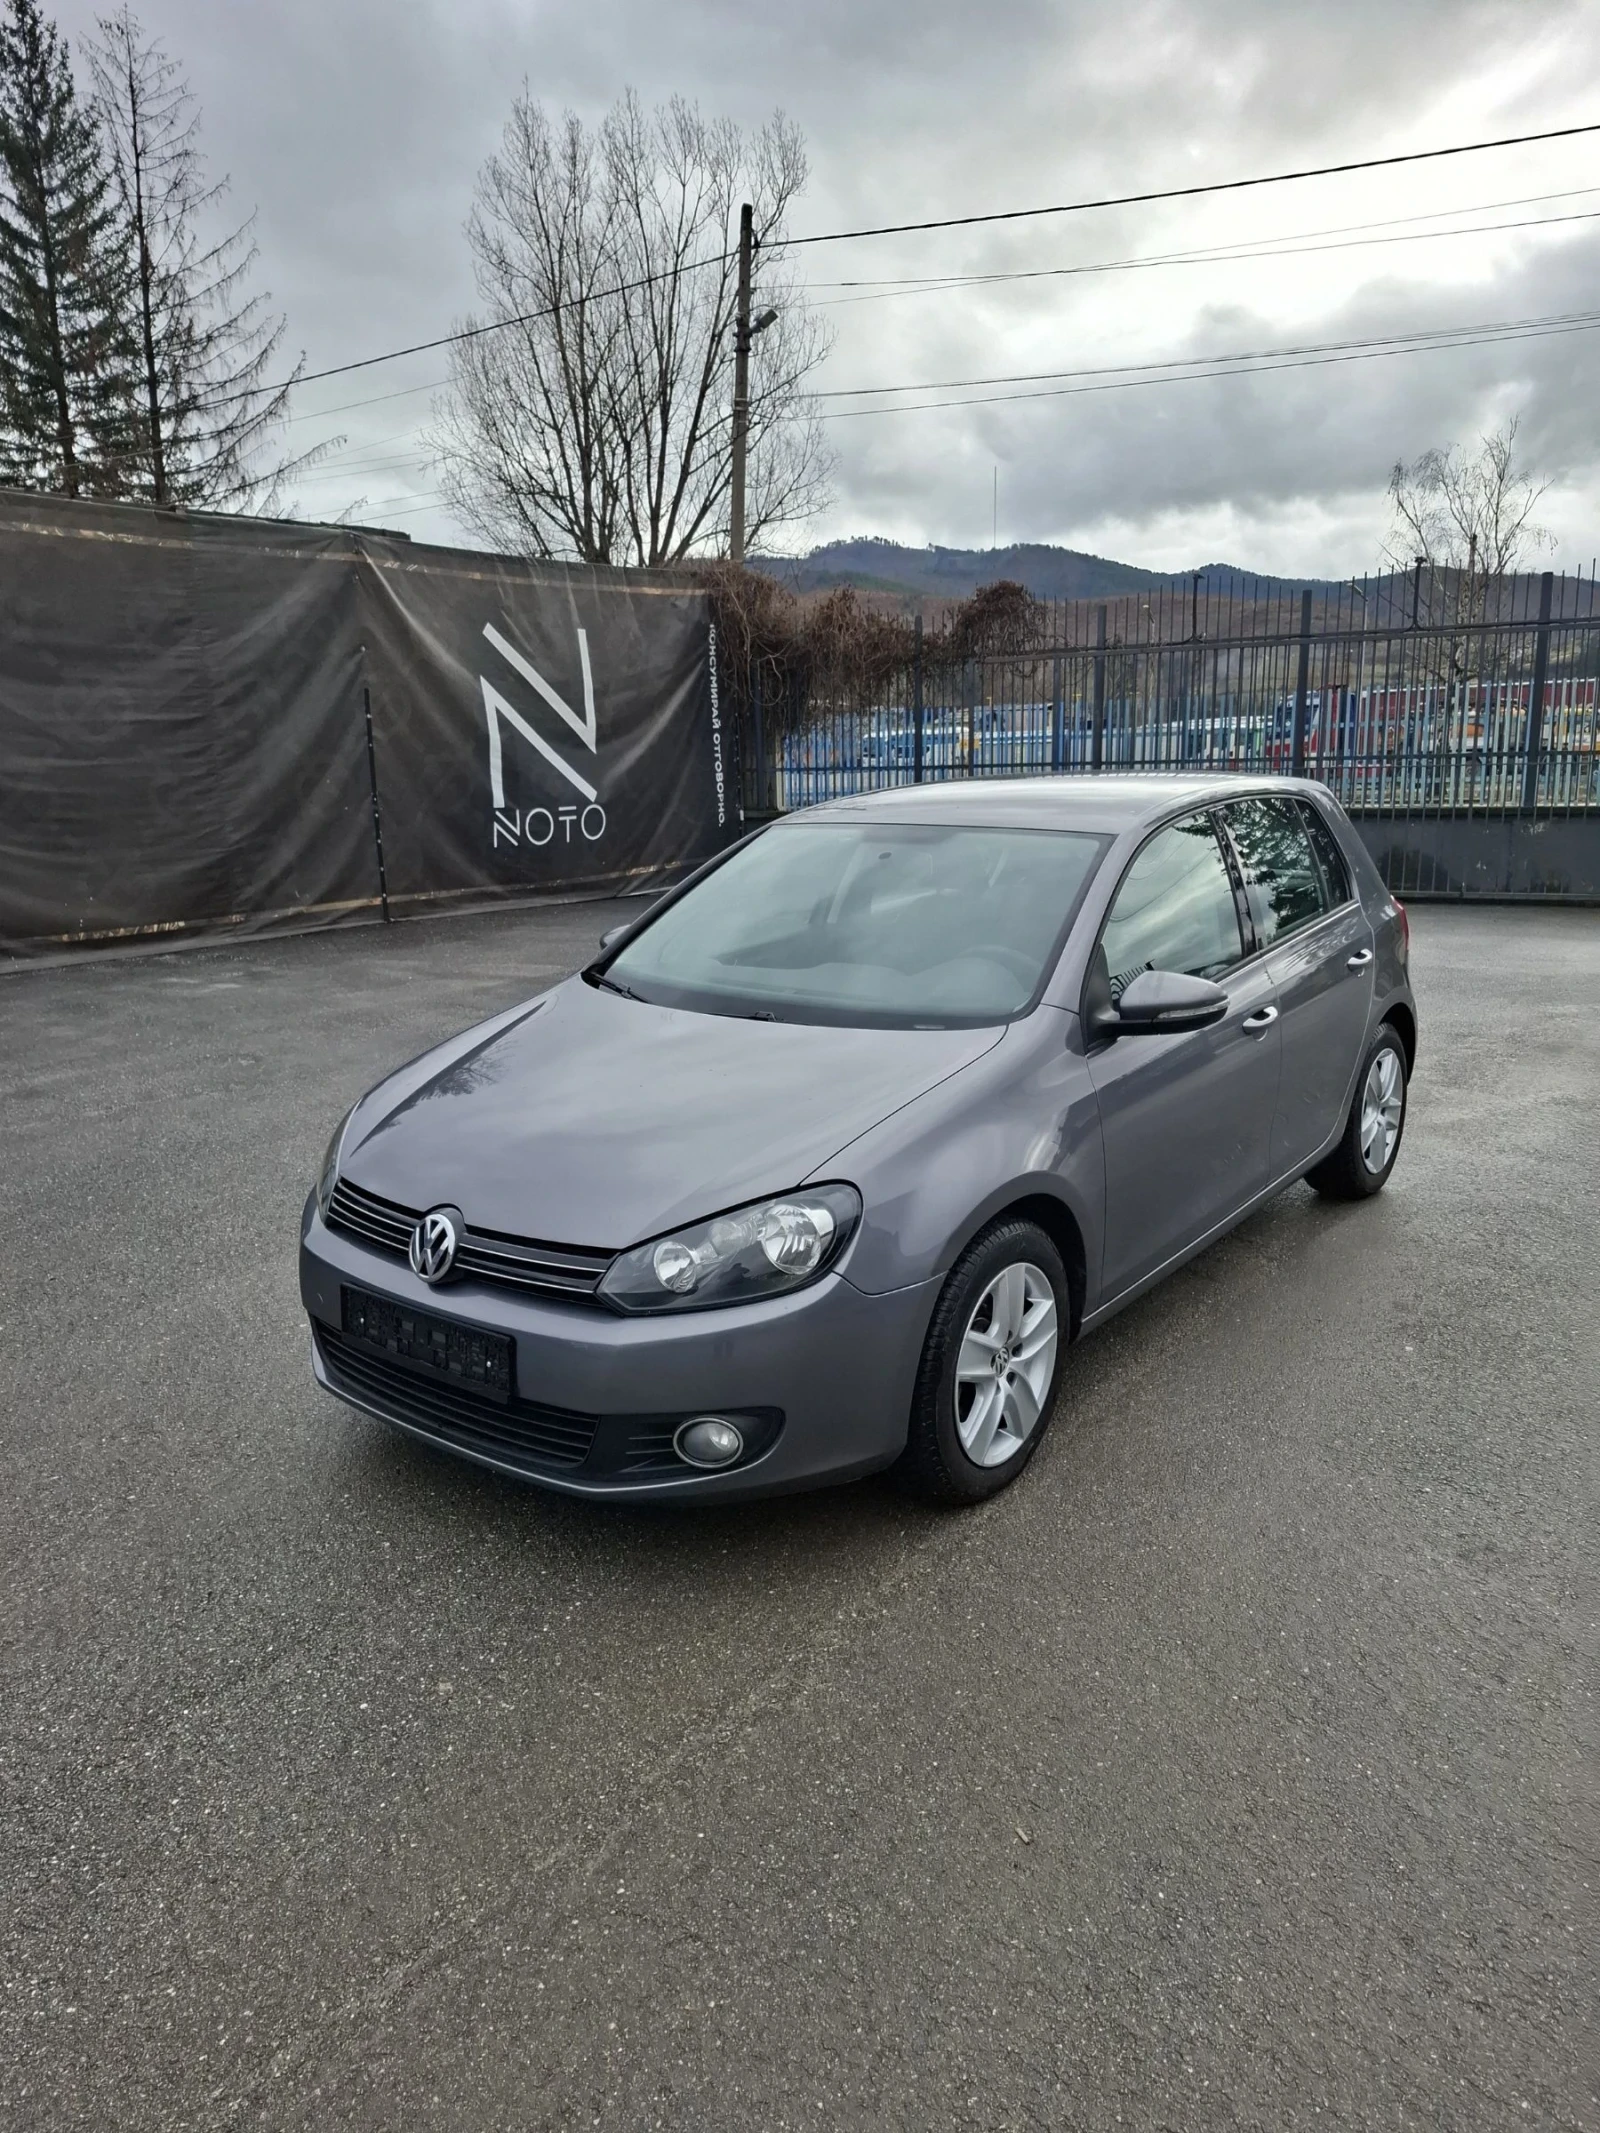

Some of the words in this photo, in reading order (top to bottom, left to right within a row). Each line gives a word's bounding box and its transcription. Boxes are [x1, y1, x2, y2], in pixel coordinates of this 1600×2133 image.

[709, 624, 721, 729] КОНСУМИРАЙ
[494, 804, 606, 848] NOTO
[713, 732, 725, 827] ОТГОВОРНО.
